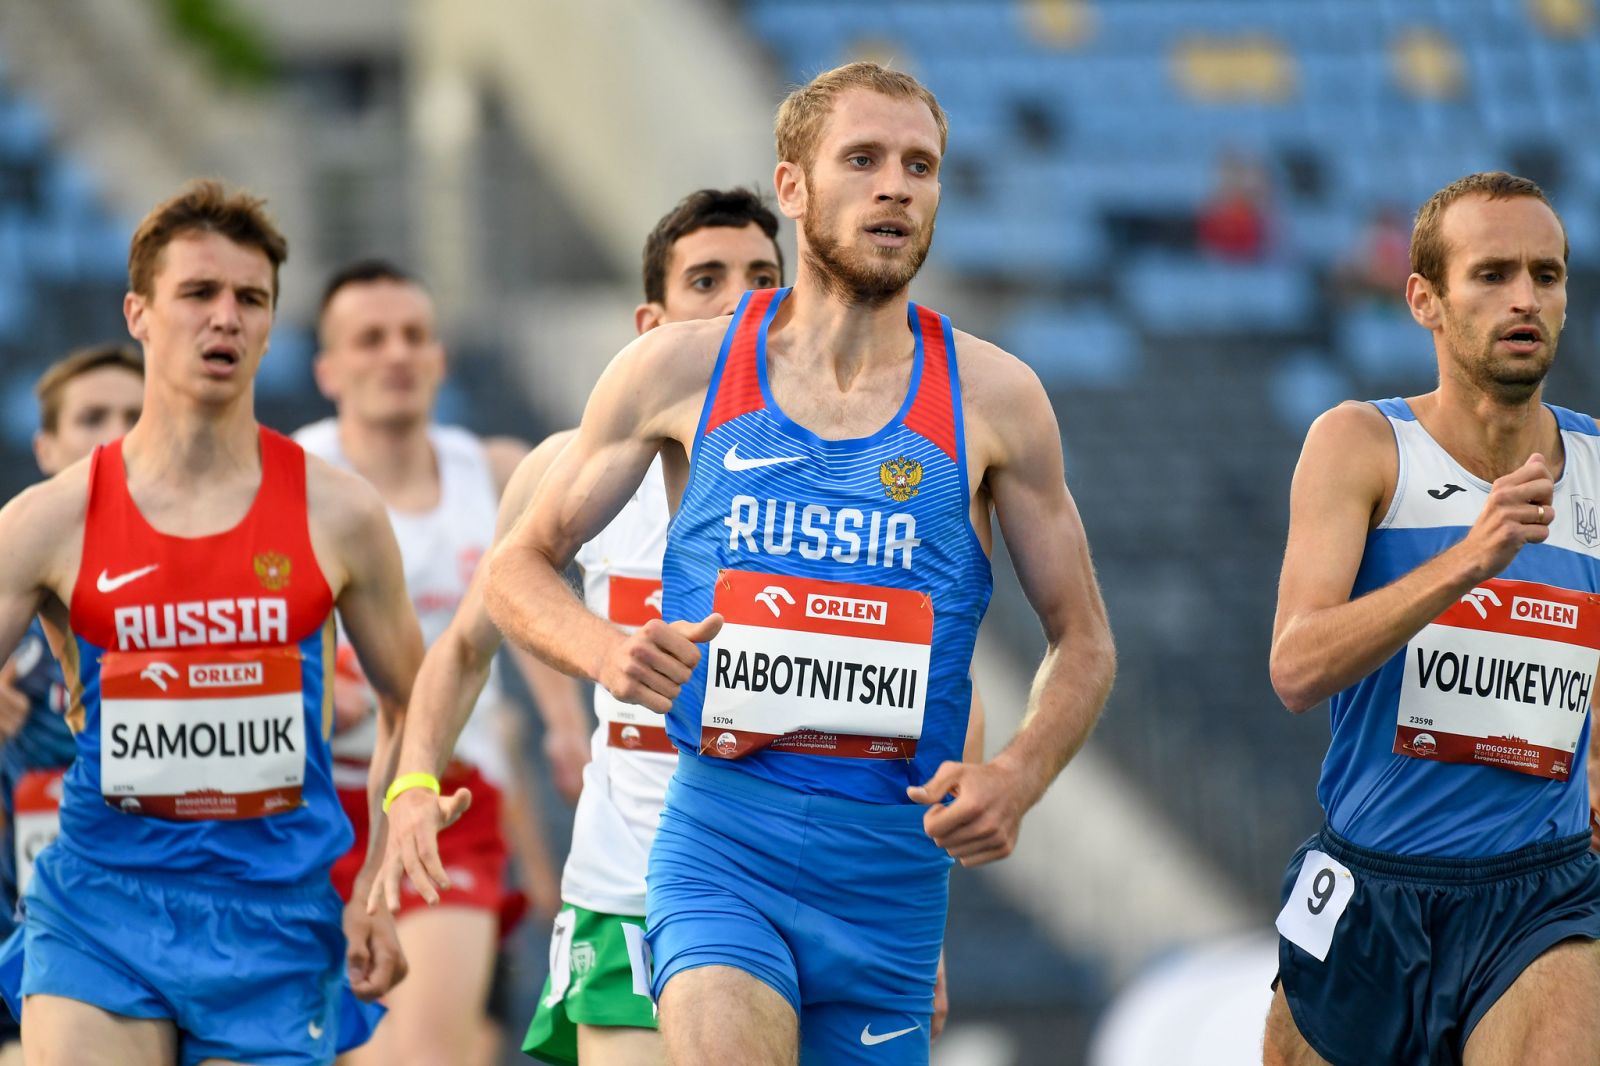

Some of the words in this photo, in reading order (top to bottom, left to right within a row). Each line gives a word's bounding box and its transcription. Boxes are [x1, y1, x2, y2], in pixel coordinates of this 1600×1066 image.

[724, 494, 922, 570] RUSSIA
[114, 597, 288, 651] RUSSIA
[811, 598, 882, 621] ORLEN
[1516, 600, 1575, 625] ORLEN
[193, 666, 258, 683] ORLEN
[714, 647, 917, 710] RABOTNITSKII
[1417, 647, 1592, 714] VOLUIKEVYCH
[712, 716, 733, 725] 15704
[1409, 716, 1434, 726] 23598
[111, 717, 295, 760] SAMOLIUK
[1476, 743, 1522, 756] BYDGOSZCZ
[1523, 749, 1540, 758] 2021
[1307, 867, 1336, 915] 9
